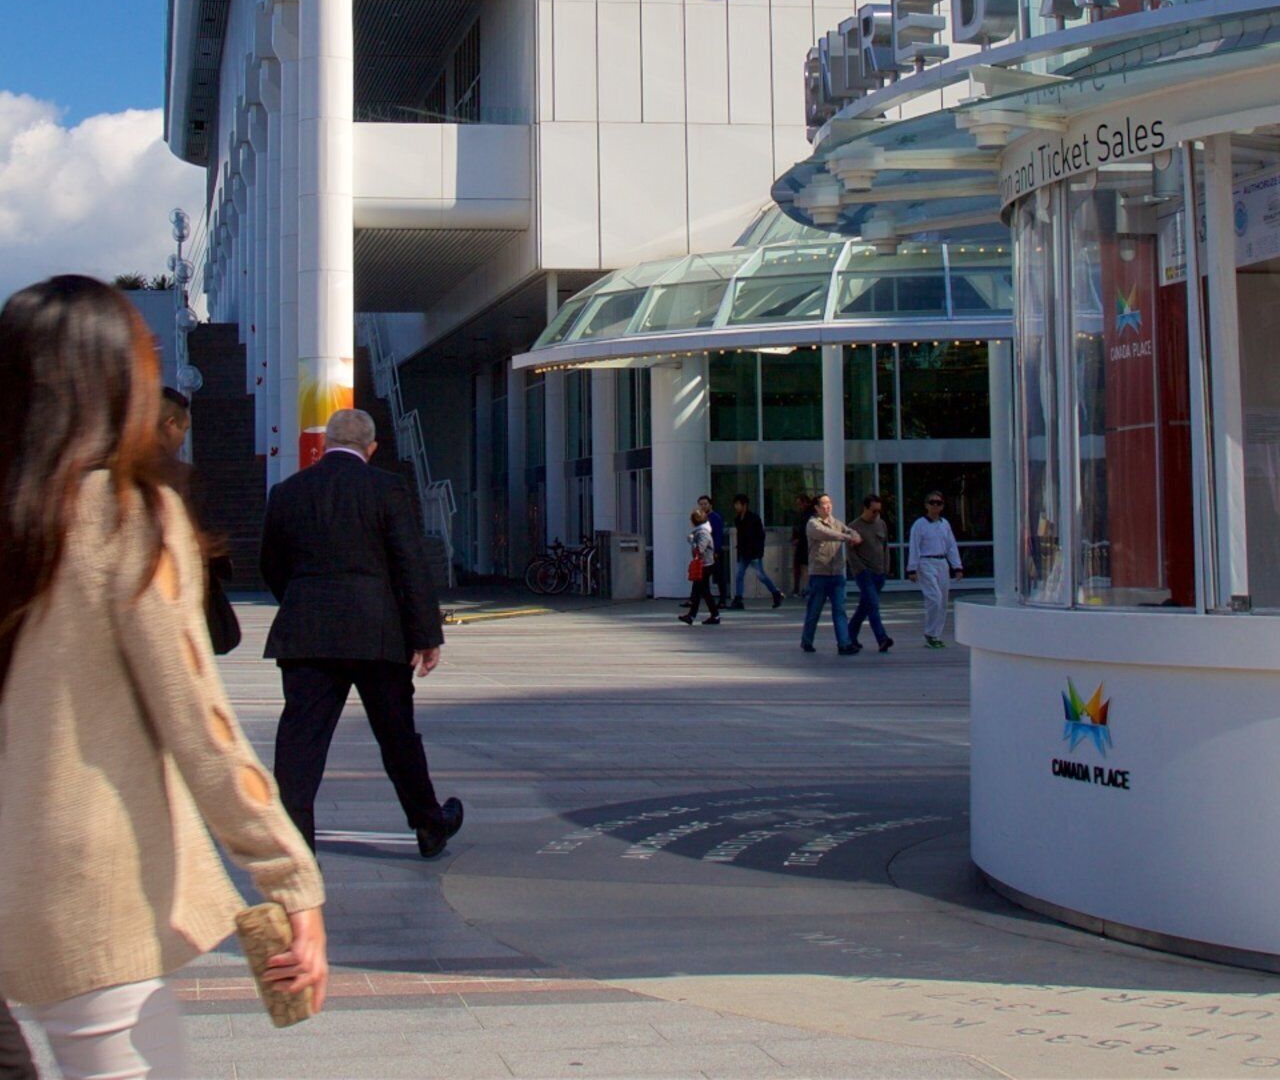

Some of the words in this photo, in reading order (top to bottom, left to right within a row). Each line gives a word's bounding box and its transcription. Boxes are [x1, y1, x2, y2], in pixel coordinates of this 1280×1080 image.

[1015, 151, 1034, 194] and
[1037, 133, 1091, 181] Ticket
[1096, 116, 1165, 163] Sales
[1132, 340, 1152, 357] PLACE
[1051, 758, 1091, 783] CANADA
[1093, 765, 1130, 790] PLACE
